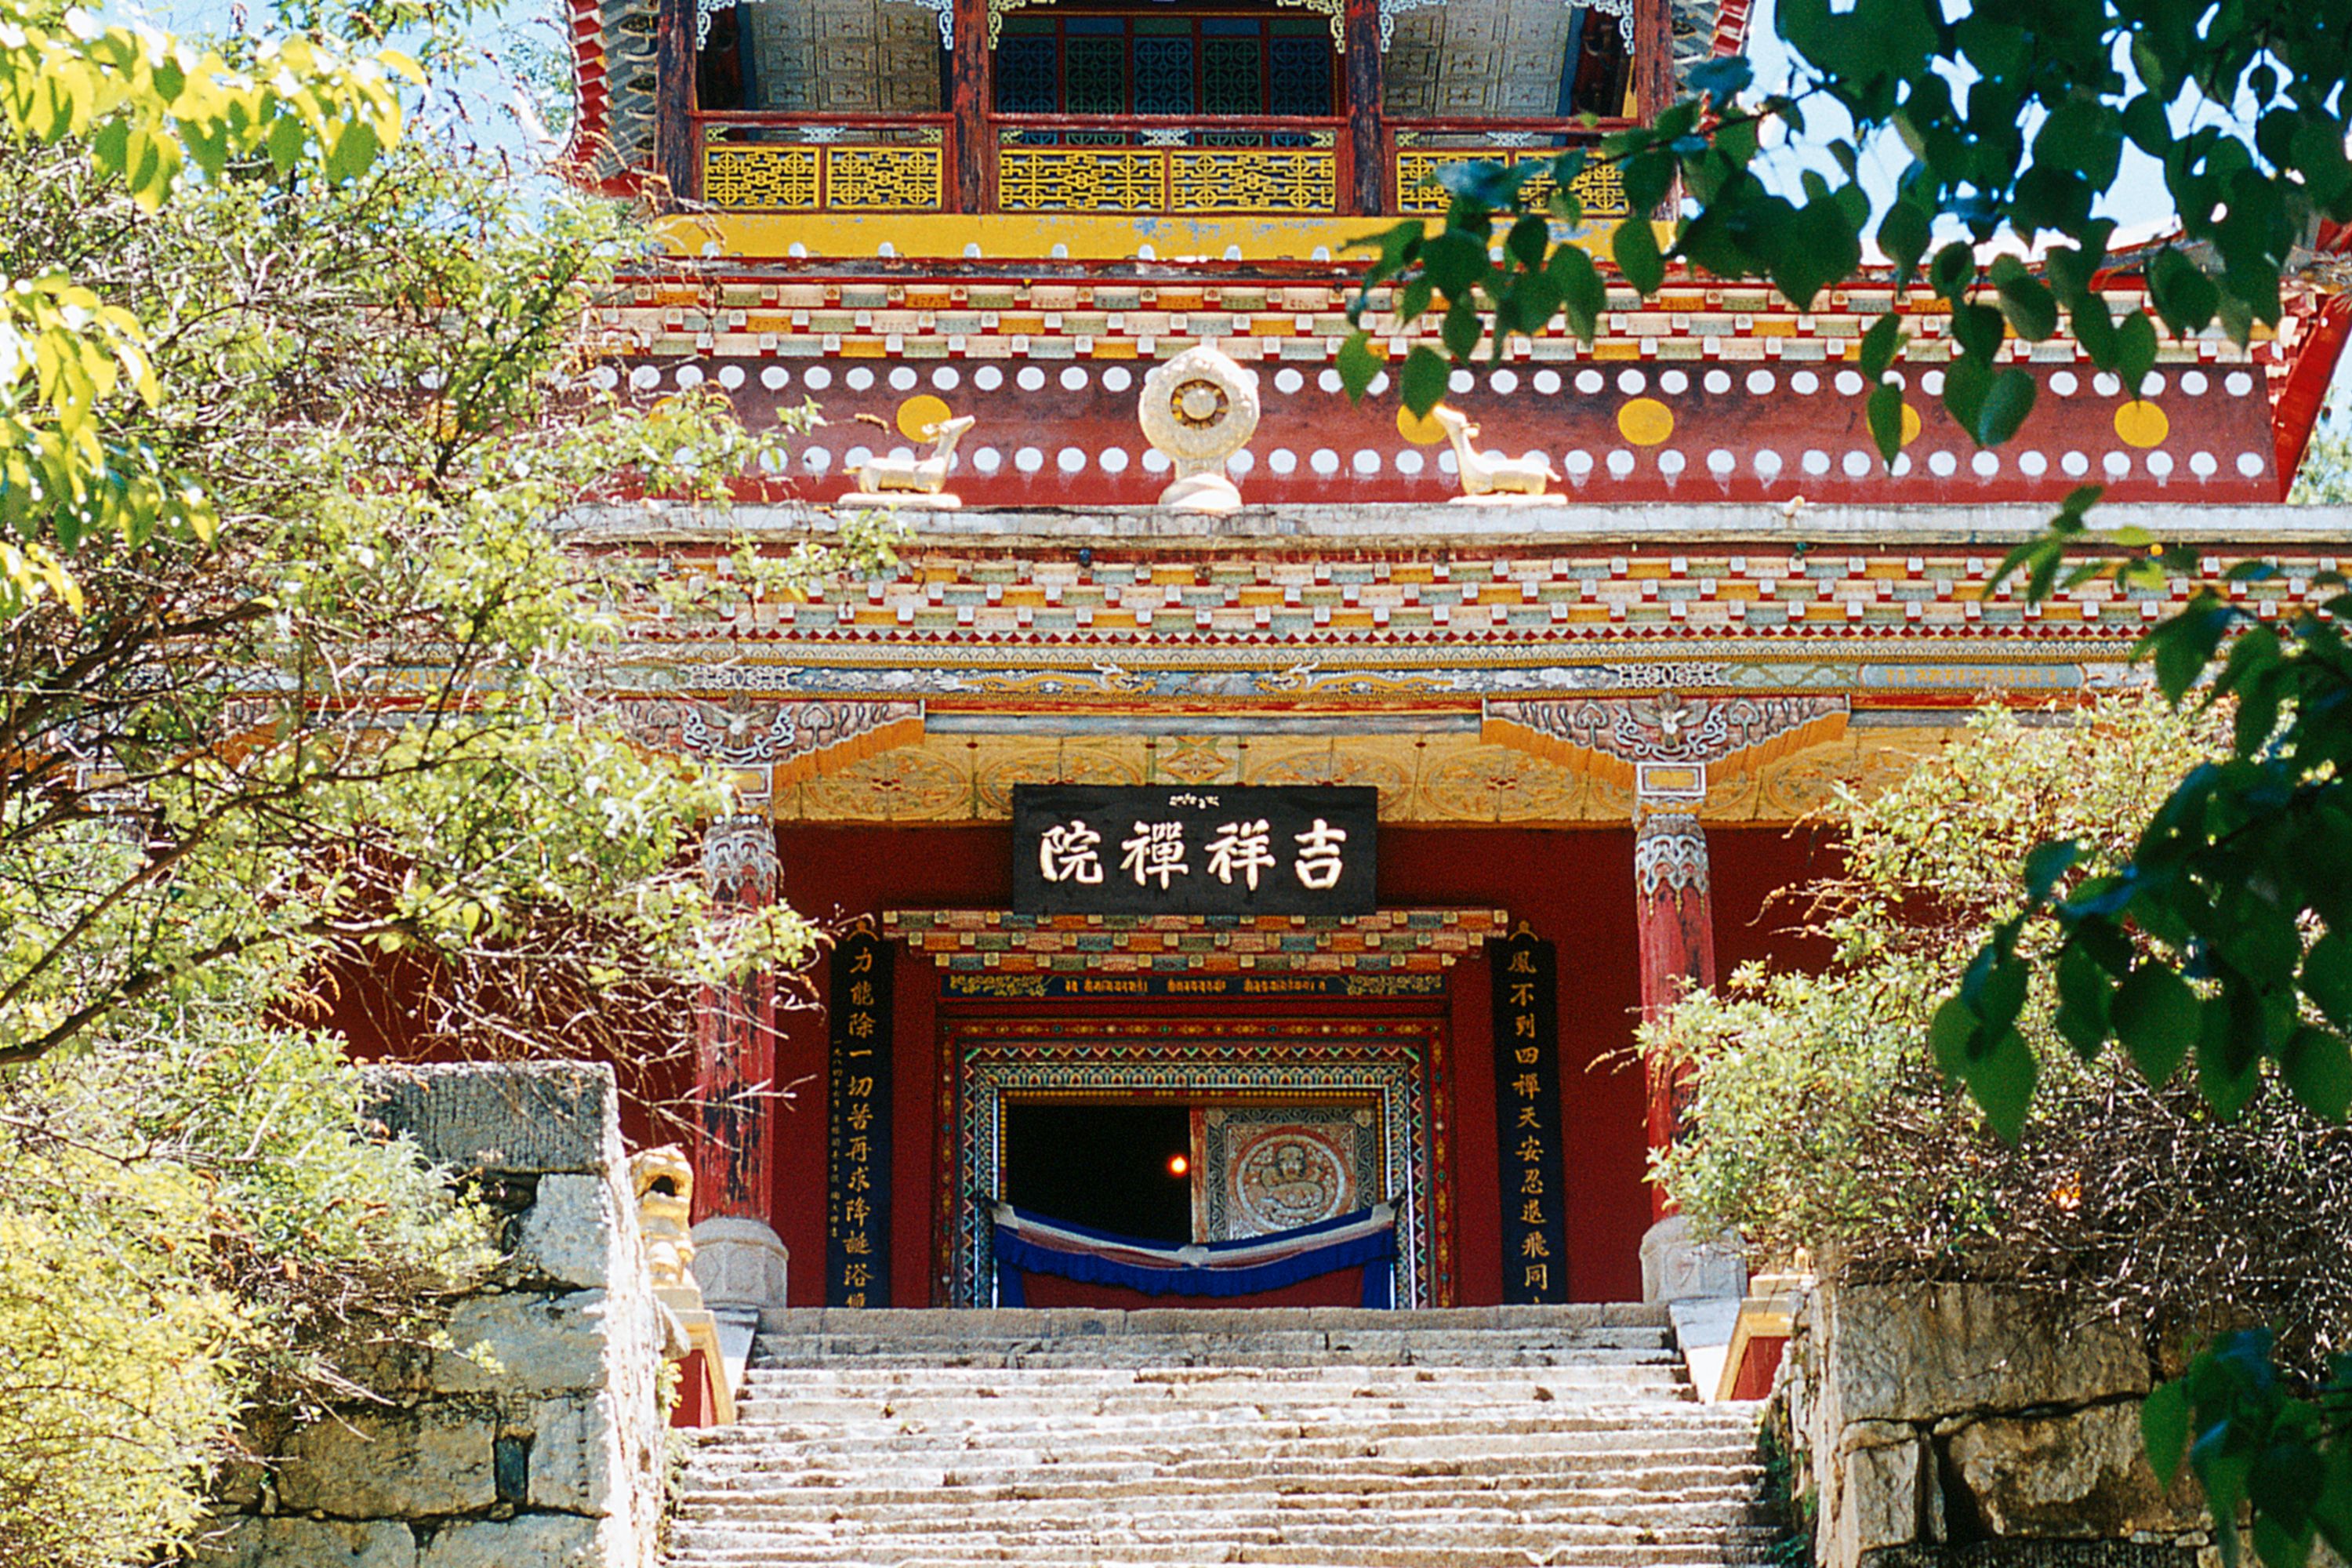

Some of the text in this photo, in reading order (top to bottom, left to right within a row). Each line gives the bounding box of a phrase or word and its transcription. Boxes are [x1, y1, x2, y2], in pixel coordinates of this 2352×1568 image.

[1039, 818, 1348, 891] 吉祥禪院
[1507, 949, 1551, 1304] 風不到四禪天安忍退飛同
